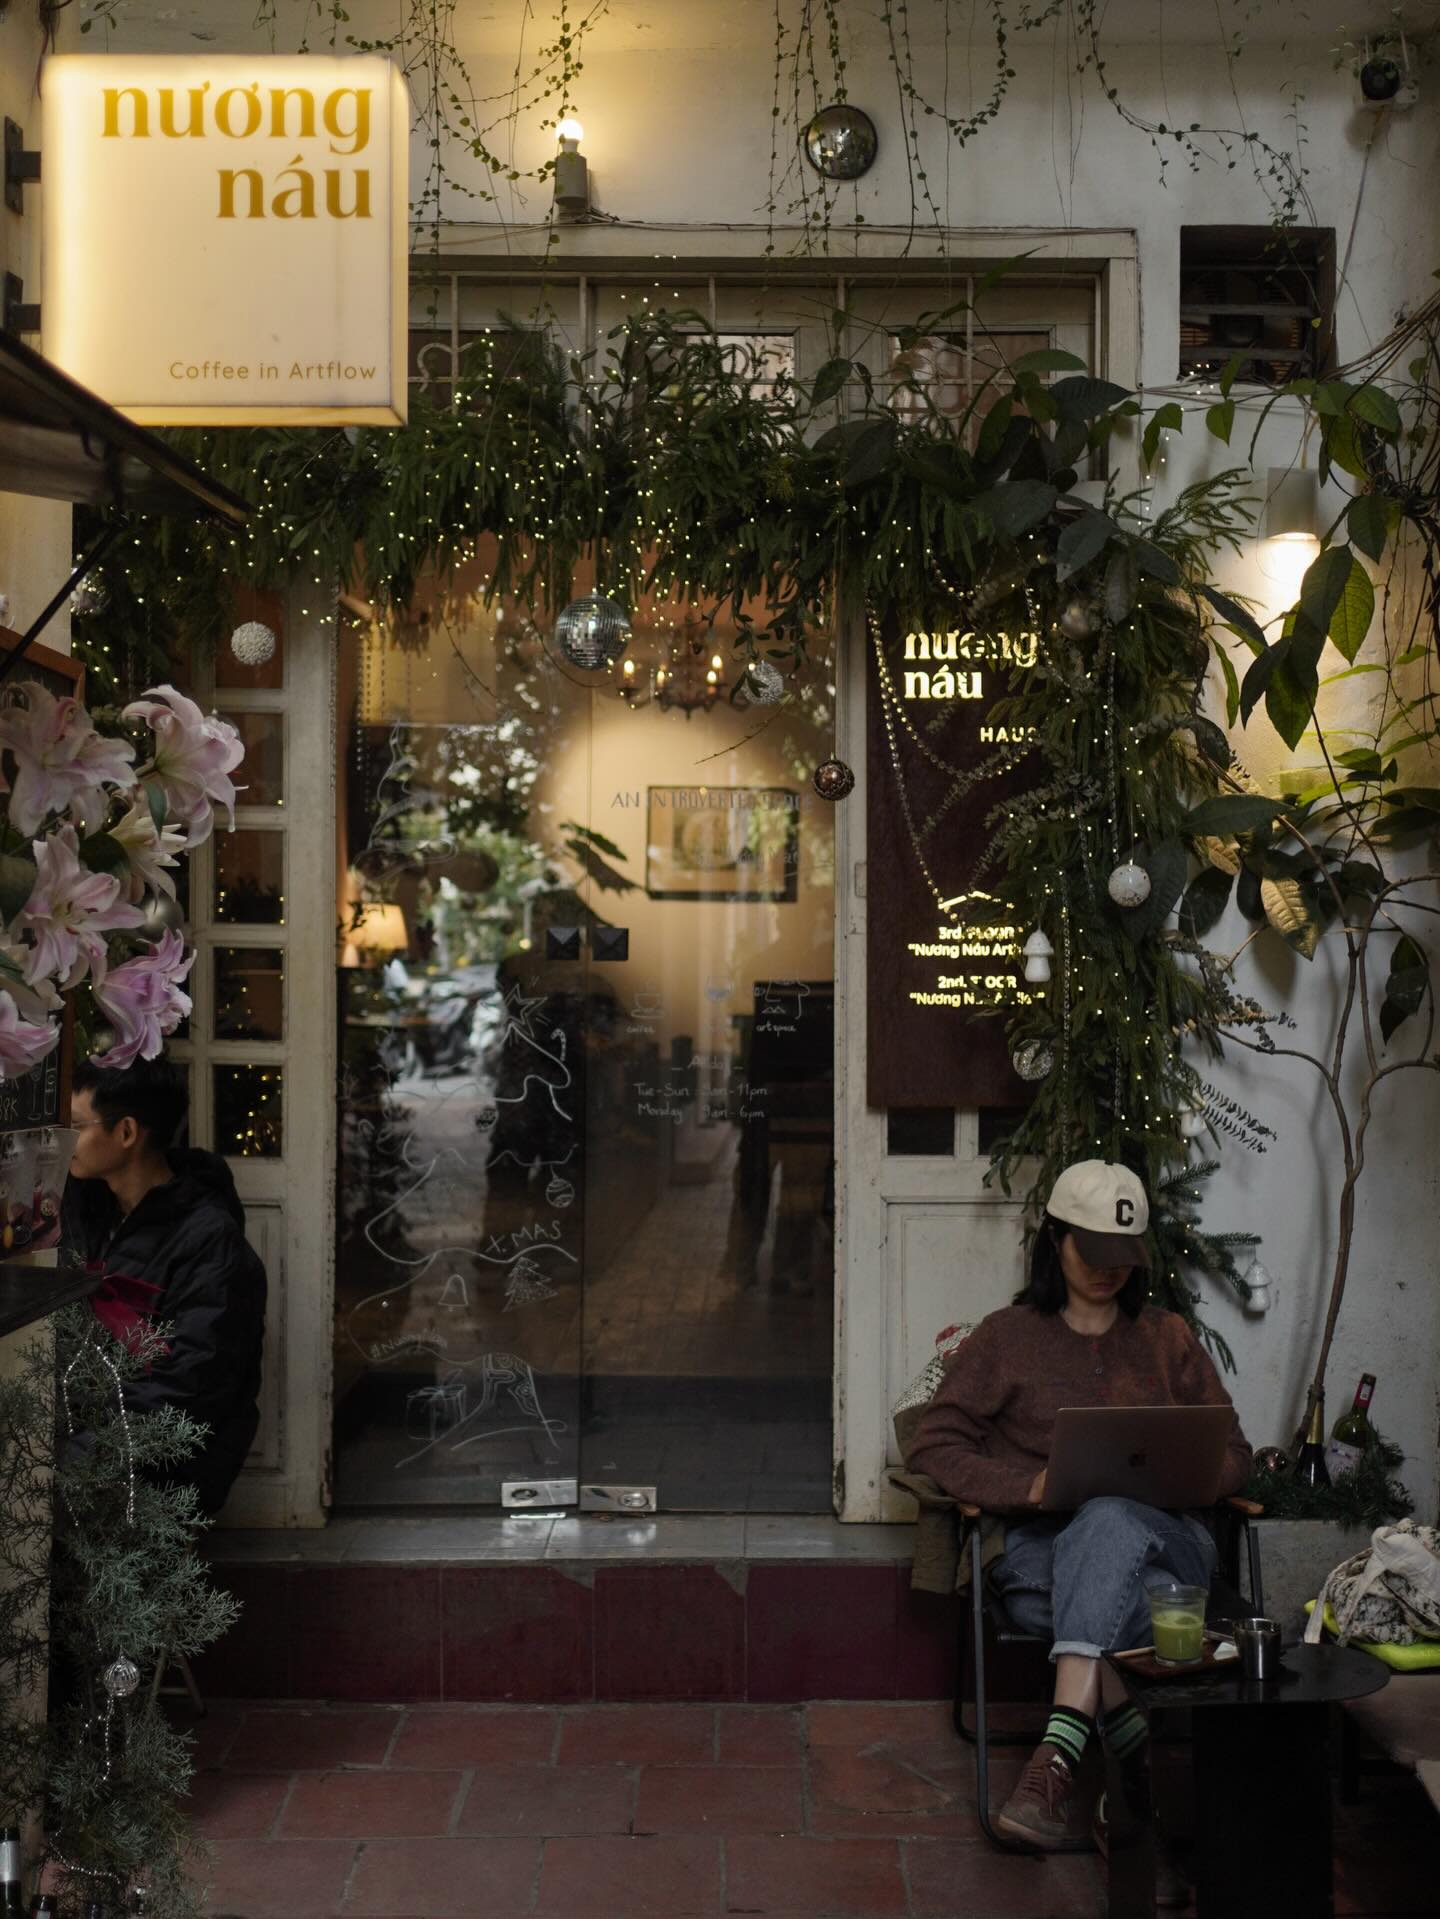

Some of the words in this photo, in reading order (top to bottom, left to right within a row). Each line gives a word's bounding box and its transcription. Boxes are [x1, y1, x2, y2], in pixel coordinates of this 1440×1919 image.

[102, 80, 373, 154] nương
[217, 154, 373, 219] náu
[169, 362, 249, 379] Coffee
[260, 362, 278, 379] in
[289, 362, 376, 379] Artflow
[904, 664, 984, 698] náu
[611, 792, 640, 808] AN
[637, 1103, 683, 1124] Monday
[1116, 1199, 1134, 1227] C
